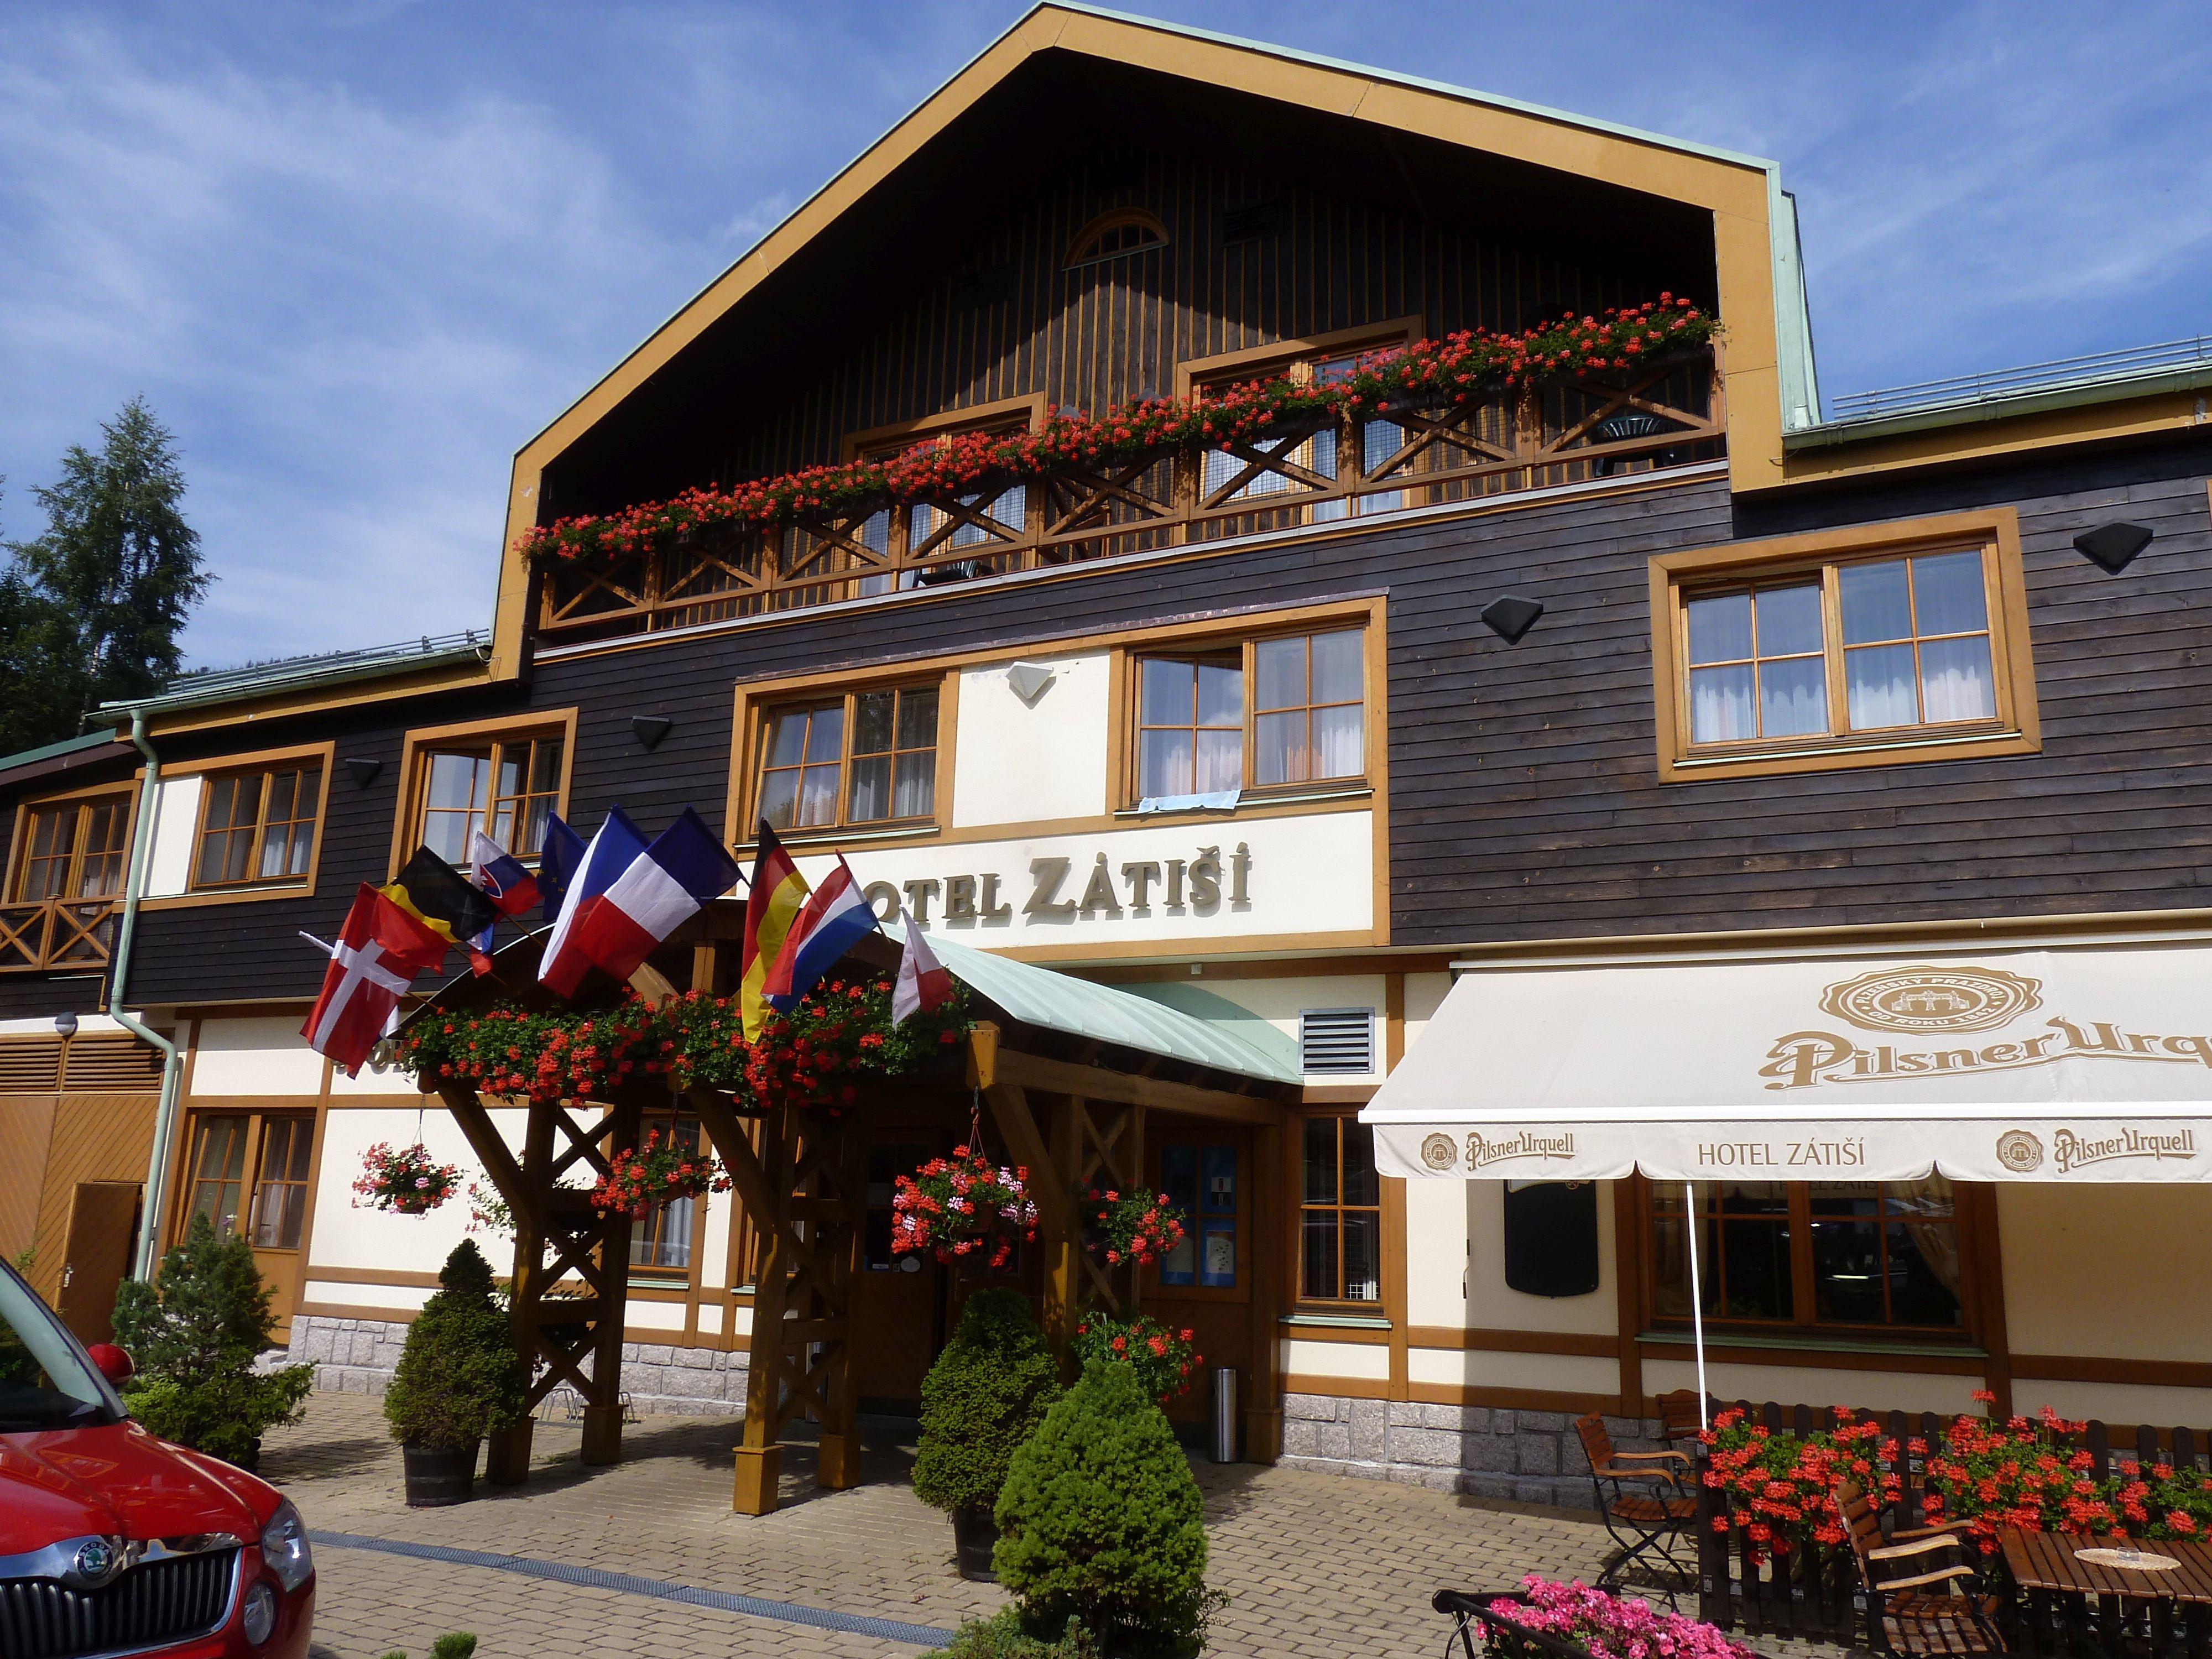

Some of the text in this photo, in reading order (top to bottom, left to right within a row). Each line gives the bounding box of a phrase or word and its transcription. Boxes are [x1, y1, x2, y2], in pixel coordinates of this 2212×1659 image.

[860, 841, 1252, 922] OTEL ZÁTIŠÍ
[1868, 1011, 1891, 1020] OD
[1956, 1008, 1997, 1023] 1842
[1757, 1030, 2057, 1091] Pilsner
[1465, 1132, 1520, 1171] Pilsner
[1519, 1130, 1574, 1160] Urquell
[1698, 1137, 1864, 1165] HOTEL ZÁTIŠÍ
[2054, 1129, 2124, 1173] Pilsner
[2121, 1127, 2194, 1161] Urquell
